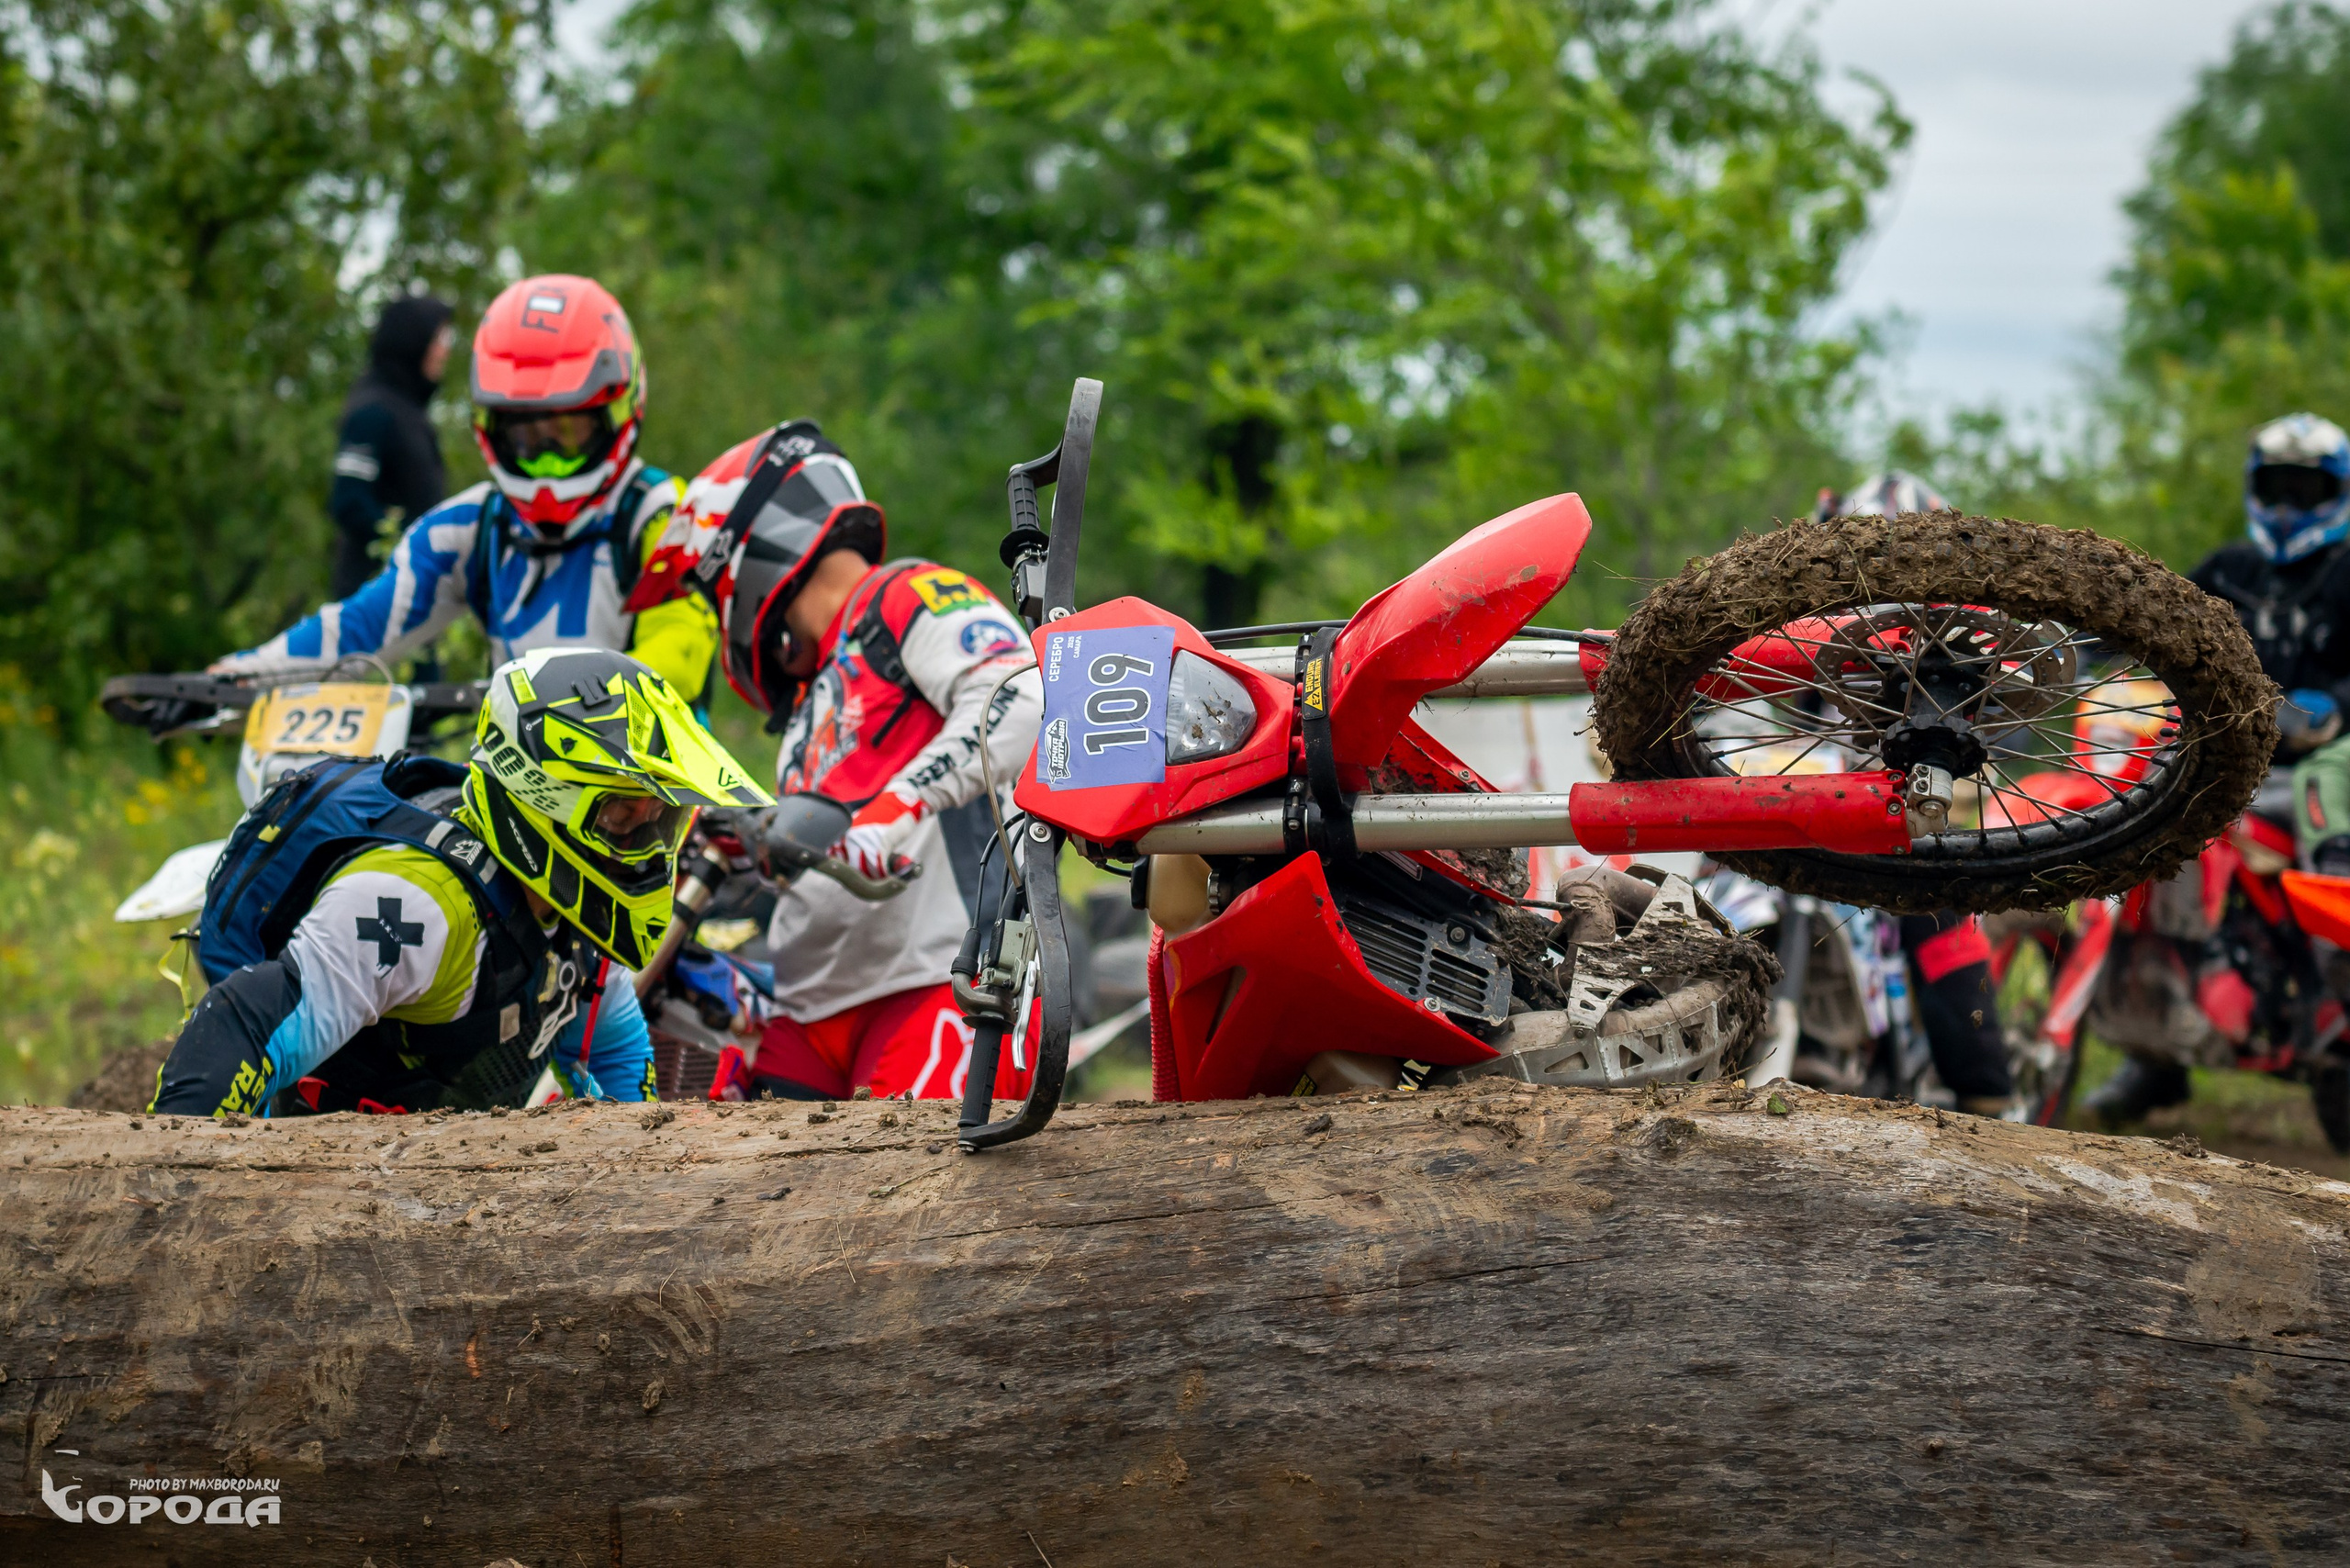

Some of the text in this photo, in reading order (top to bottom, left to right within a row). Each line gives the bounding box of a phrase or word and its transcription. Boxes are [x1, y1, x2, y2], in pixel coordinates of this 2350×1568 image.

[1048, 636, 1064, 682] СЕРЕБРО
[1073, 634, 1082, 659] САМАРА
[1305, 660, 1316, 693] ENDURO
[1084, 653, 1154, 755] 109
[1311, 691, 1321, 706] E2
[277, 708, 364, 743] 225
[482, 722, 572, 812] 00%
[1051, 737, 1059, 767] ТОЧКА
